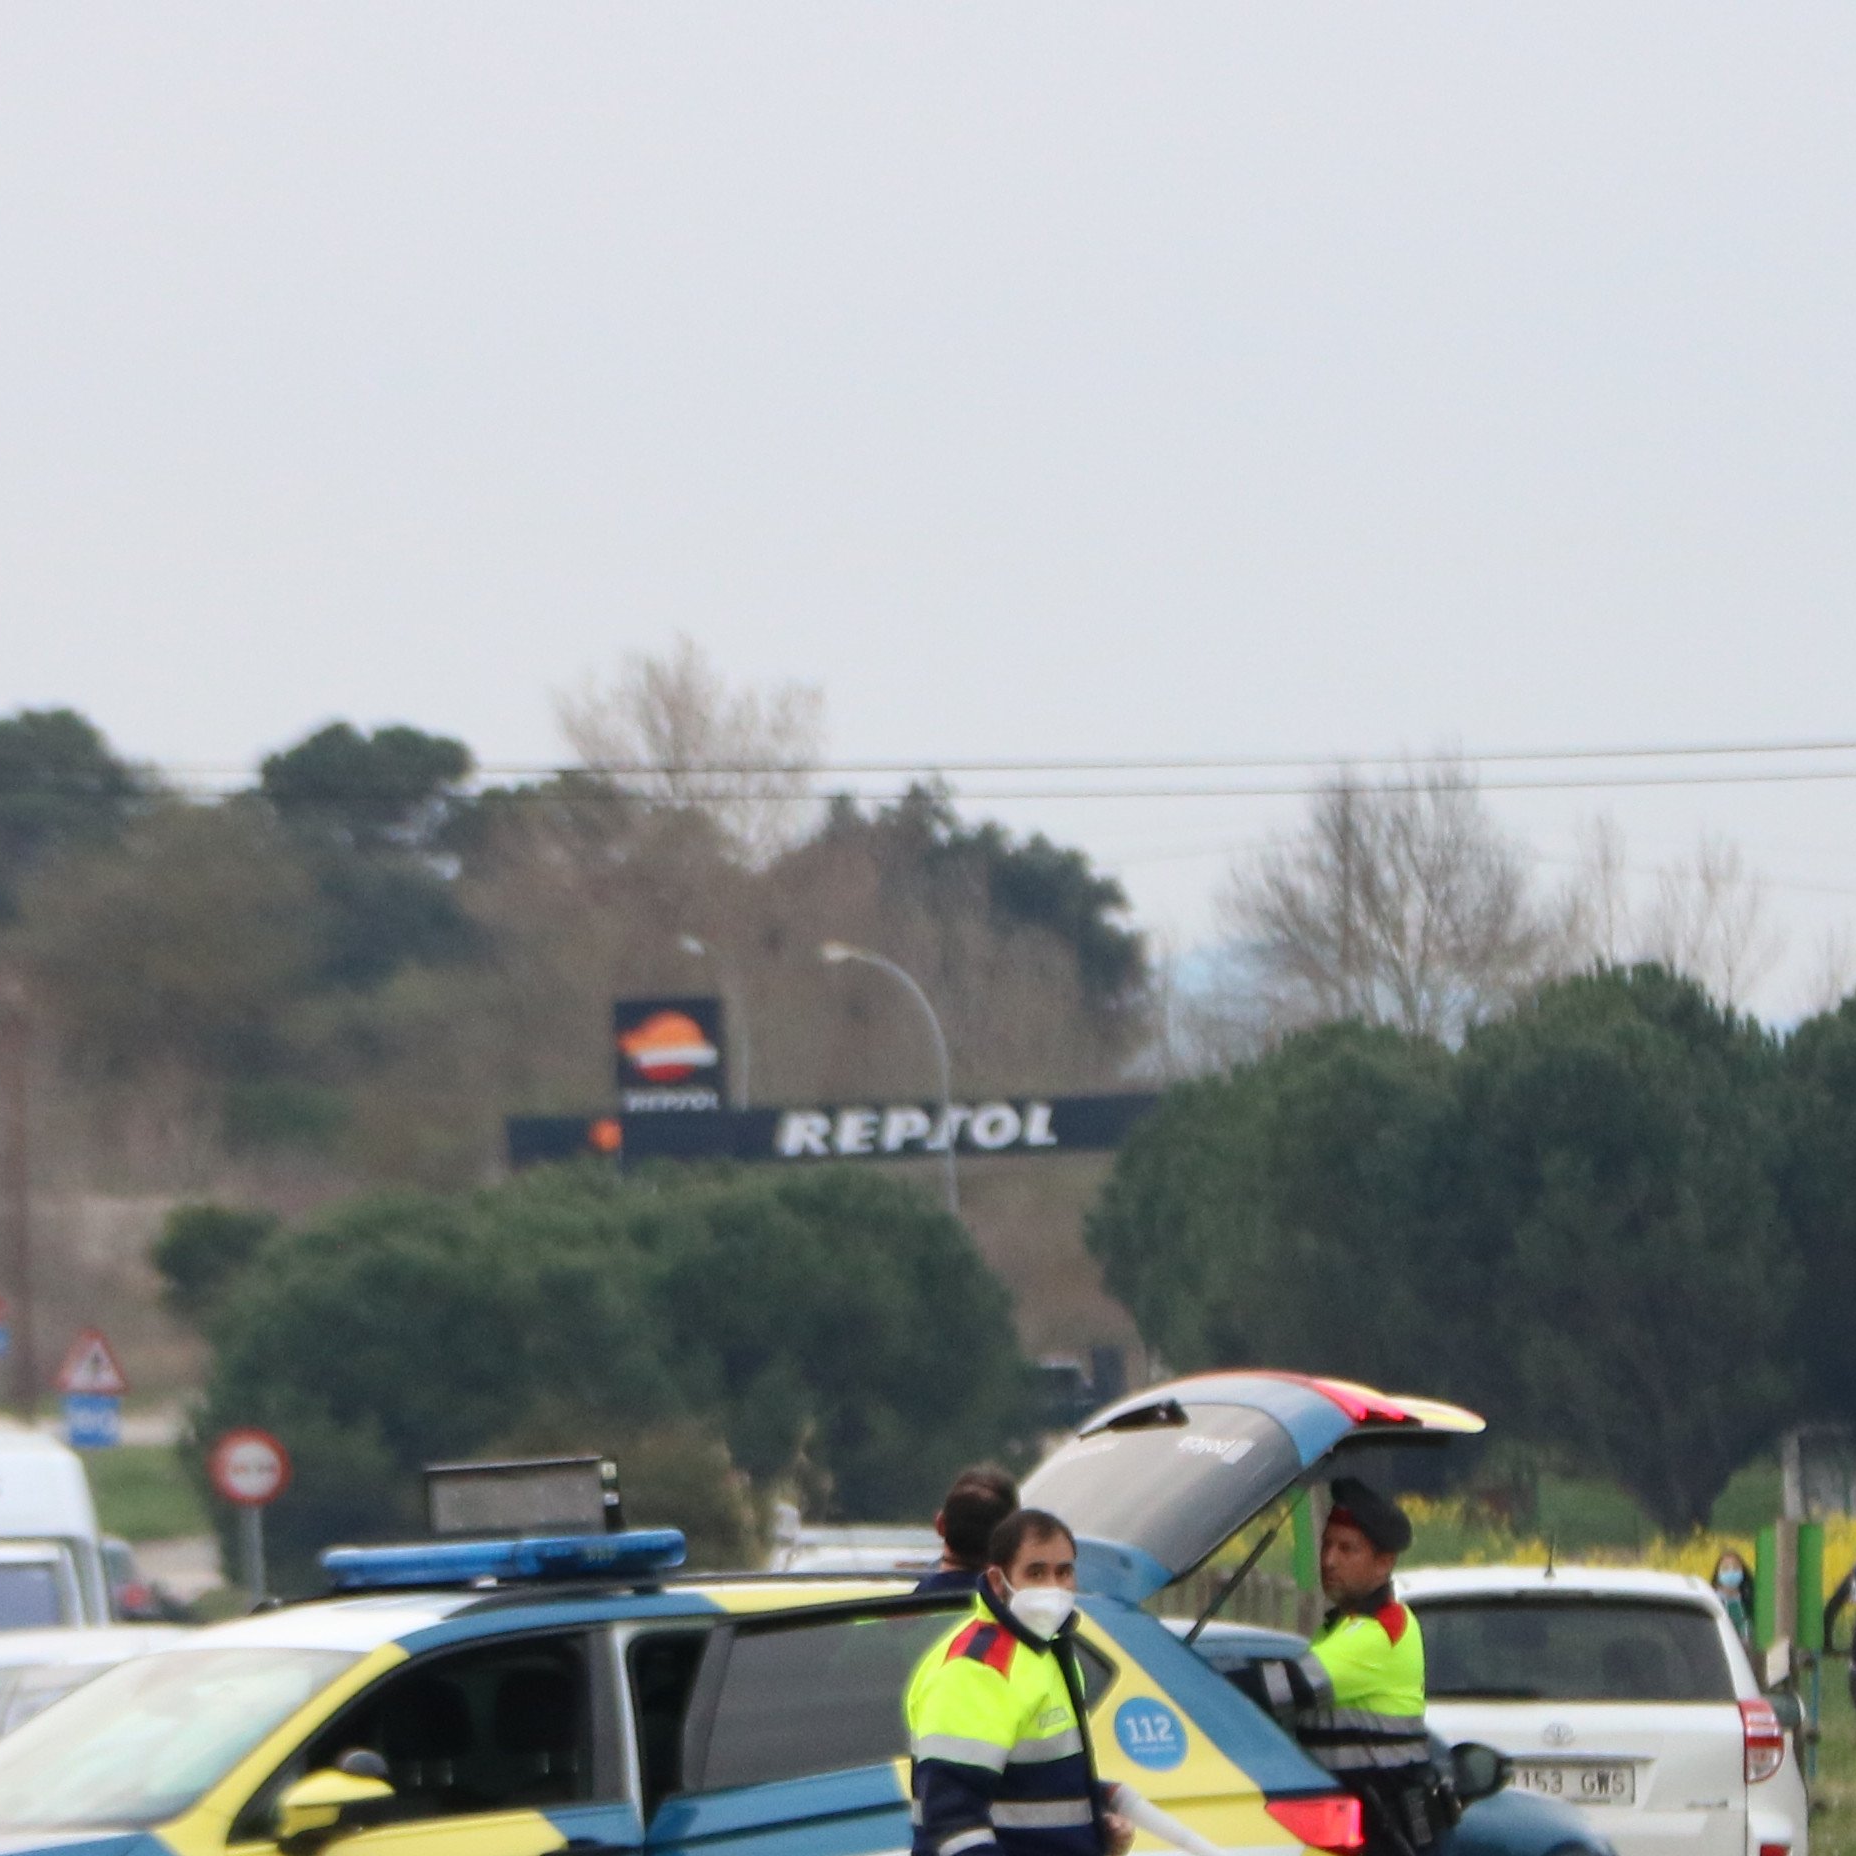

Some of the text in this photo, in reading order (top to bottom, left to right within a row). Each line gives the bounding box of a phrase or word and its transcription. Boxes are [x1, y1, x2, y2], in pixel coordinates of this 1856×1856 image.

[778, 1103, 1057, 1157] REPSOL
[1125, 1714, 1174, 1744] 112
[1580, 1768, 1625, 1795] GWS
